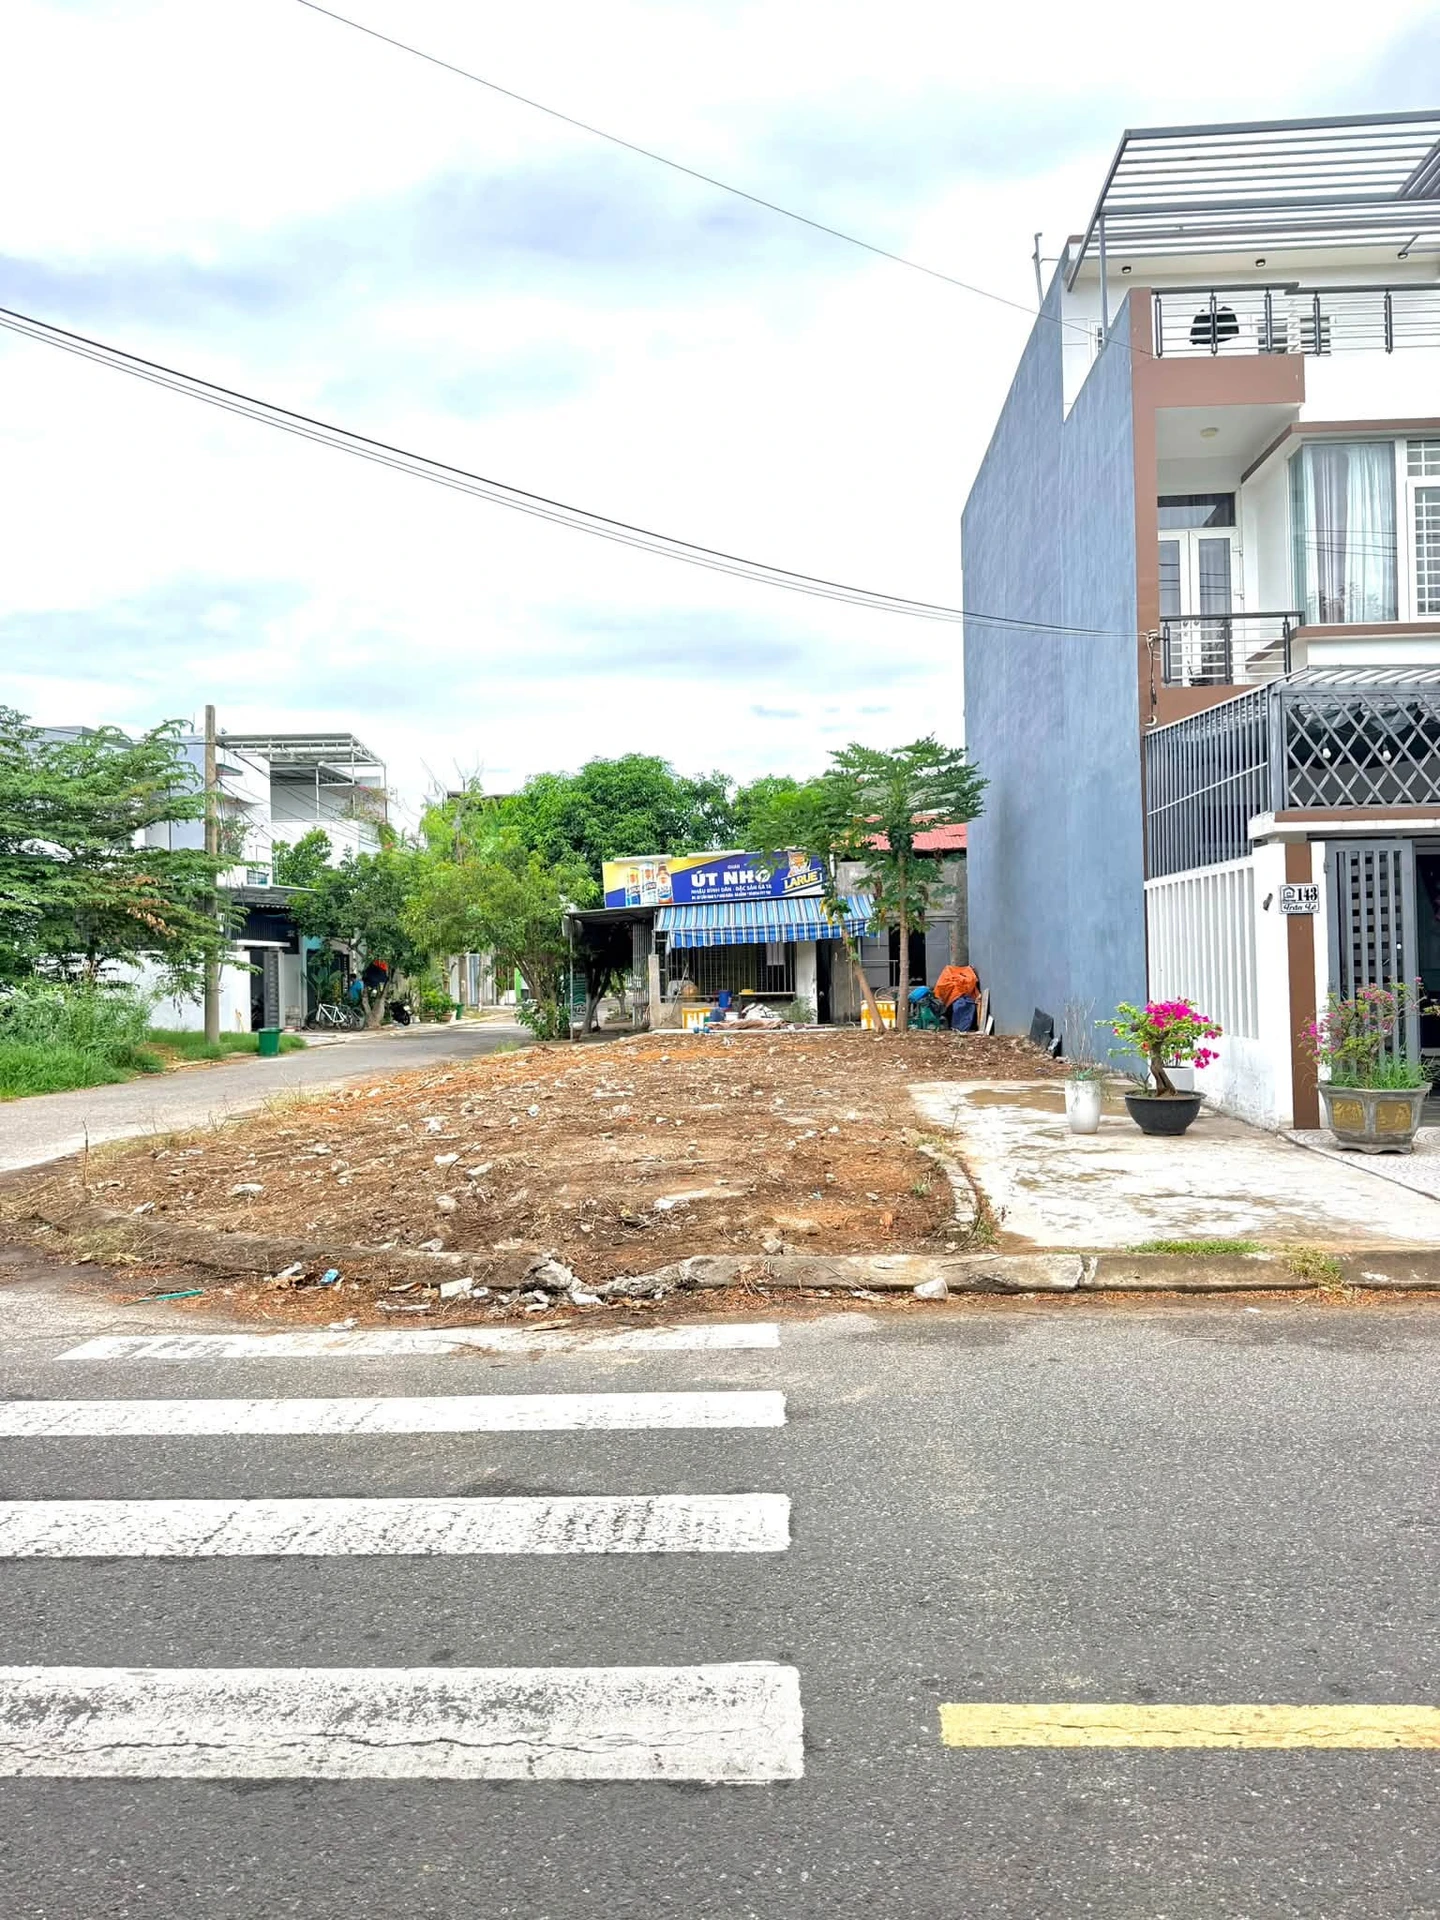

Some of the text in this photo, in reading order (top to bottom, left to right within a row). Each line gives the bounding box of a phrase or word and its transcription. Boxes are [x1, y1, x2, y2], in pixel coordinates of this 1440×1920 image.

[691, 870, 718, 887] ÚT
[784, 871, 818, 889] LARUE
[1297, 887, 1318, 901] 143
